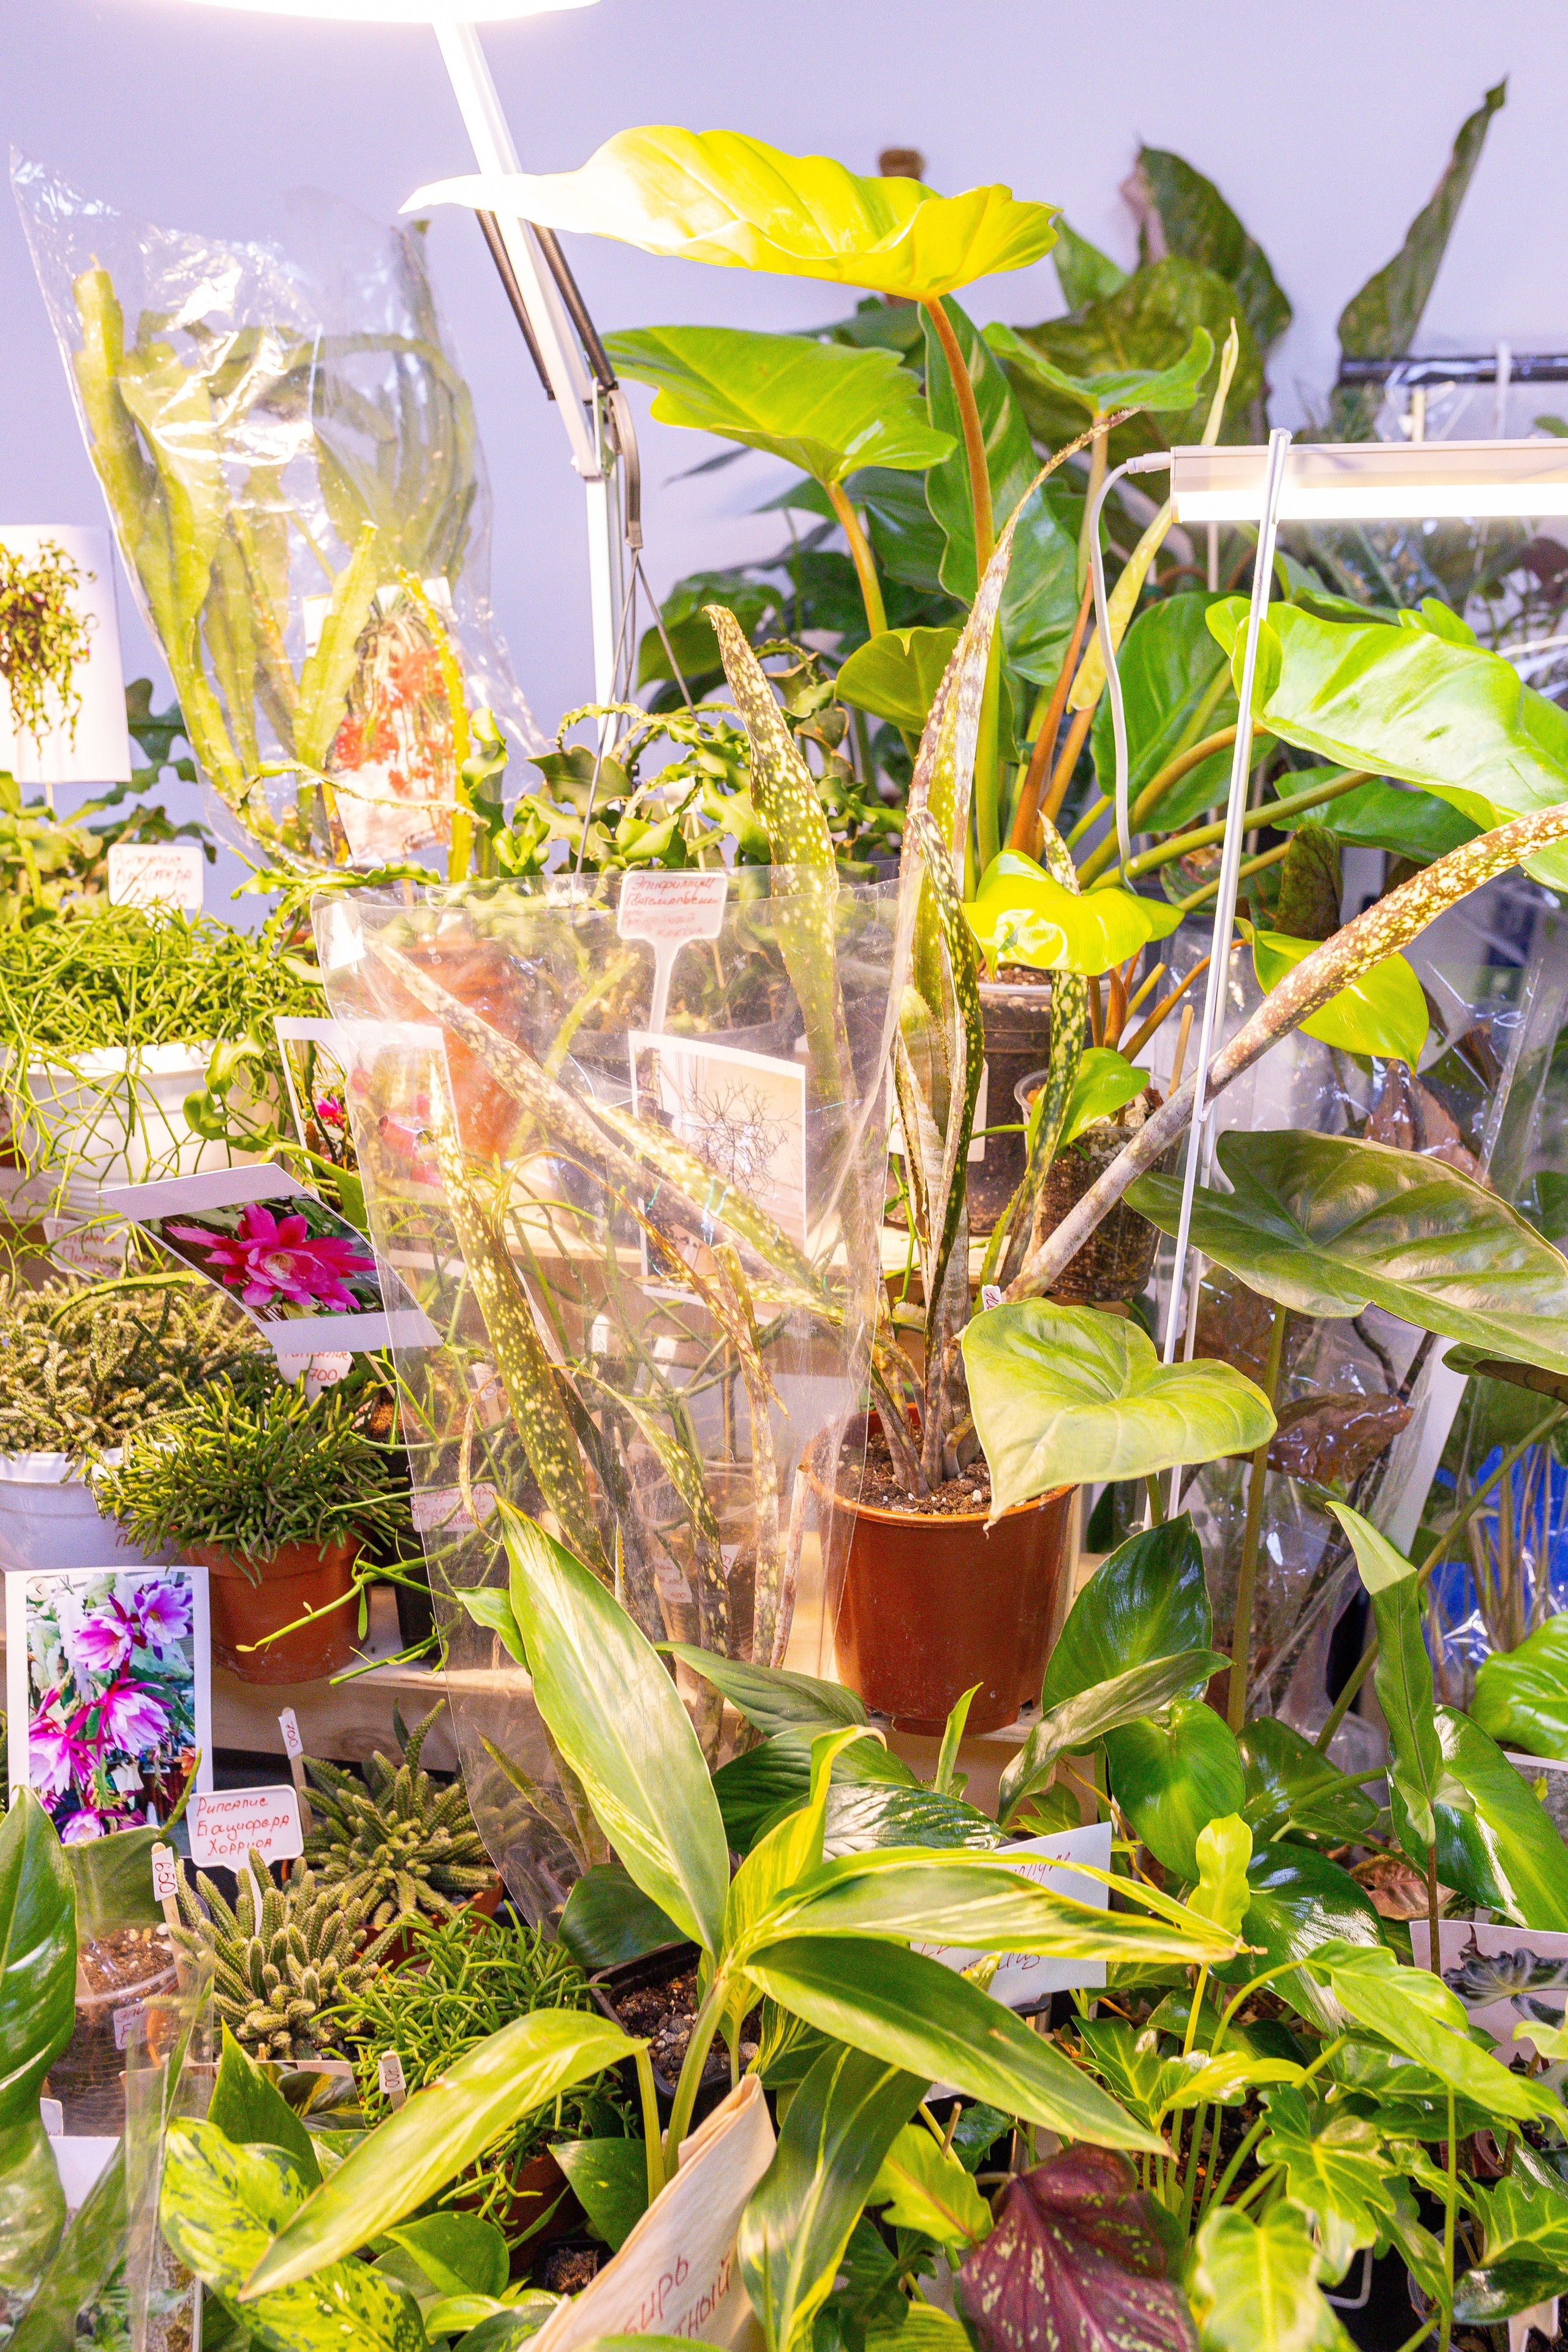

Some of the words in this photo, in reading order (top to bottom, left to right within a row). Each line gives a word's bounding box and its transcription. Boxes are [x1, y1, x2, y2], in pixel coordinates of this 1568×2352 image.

[307, 1368, 337, 1381] 700
[196, 1796, 270, 1817] Рипсалис
[197, 1815, 290, 1841] Бацифера
[154, 1863, 176, 1893] 650
